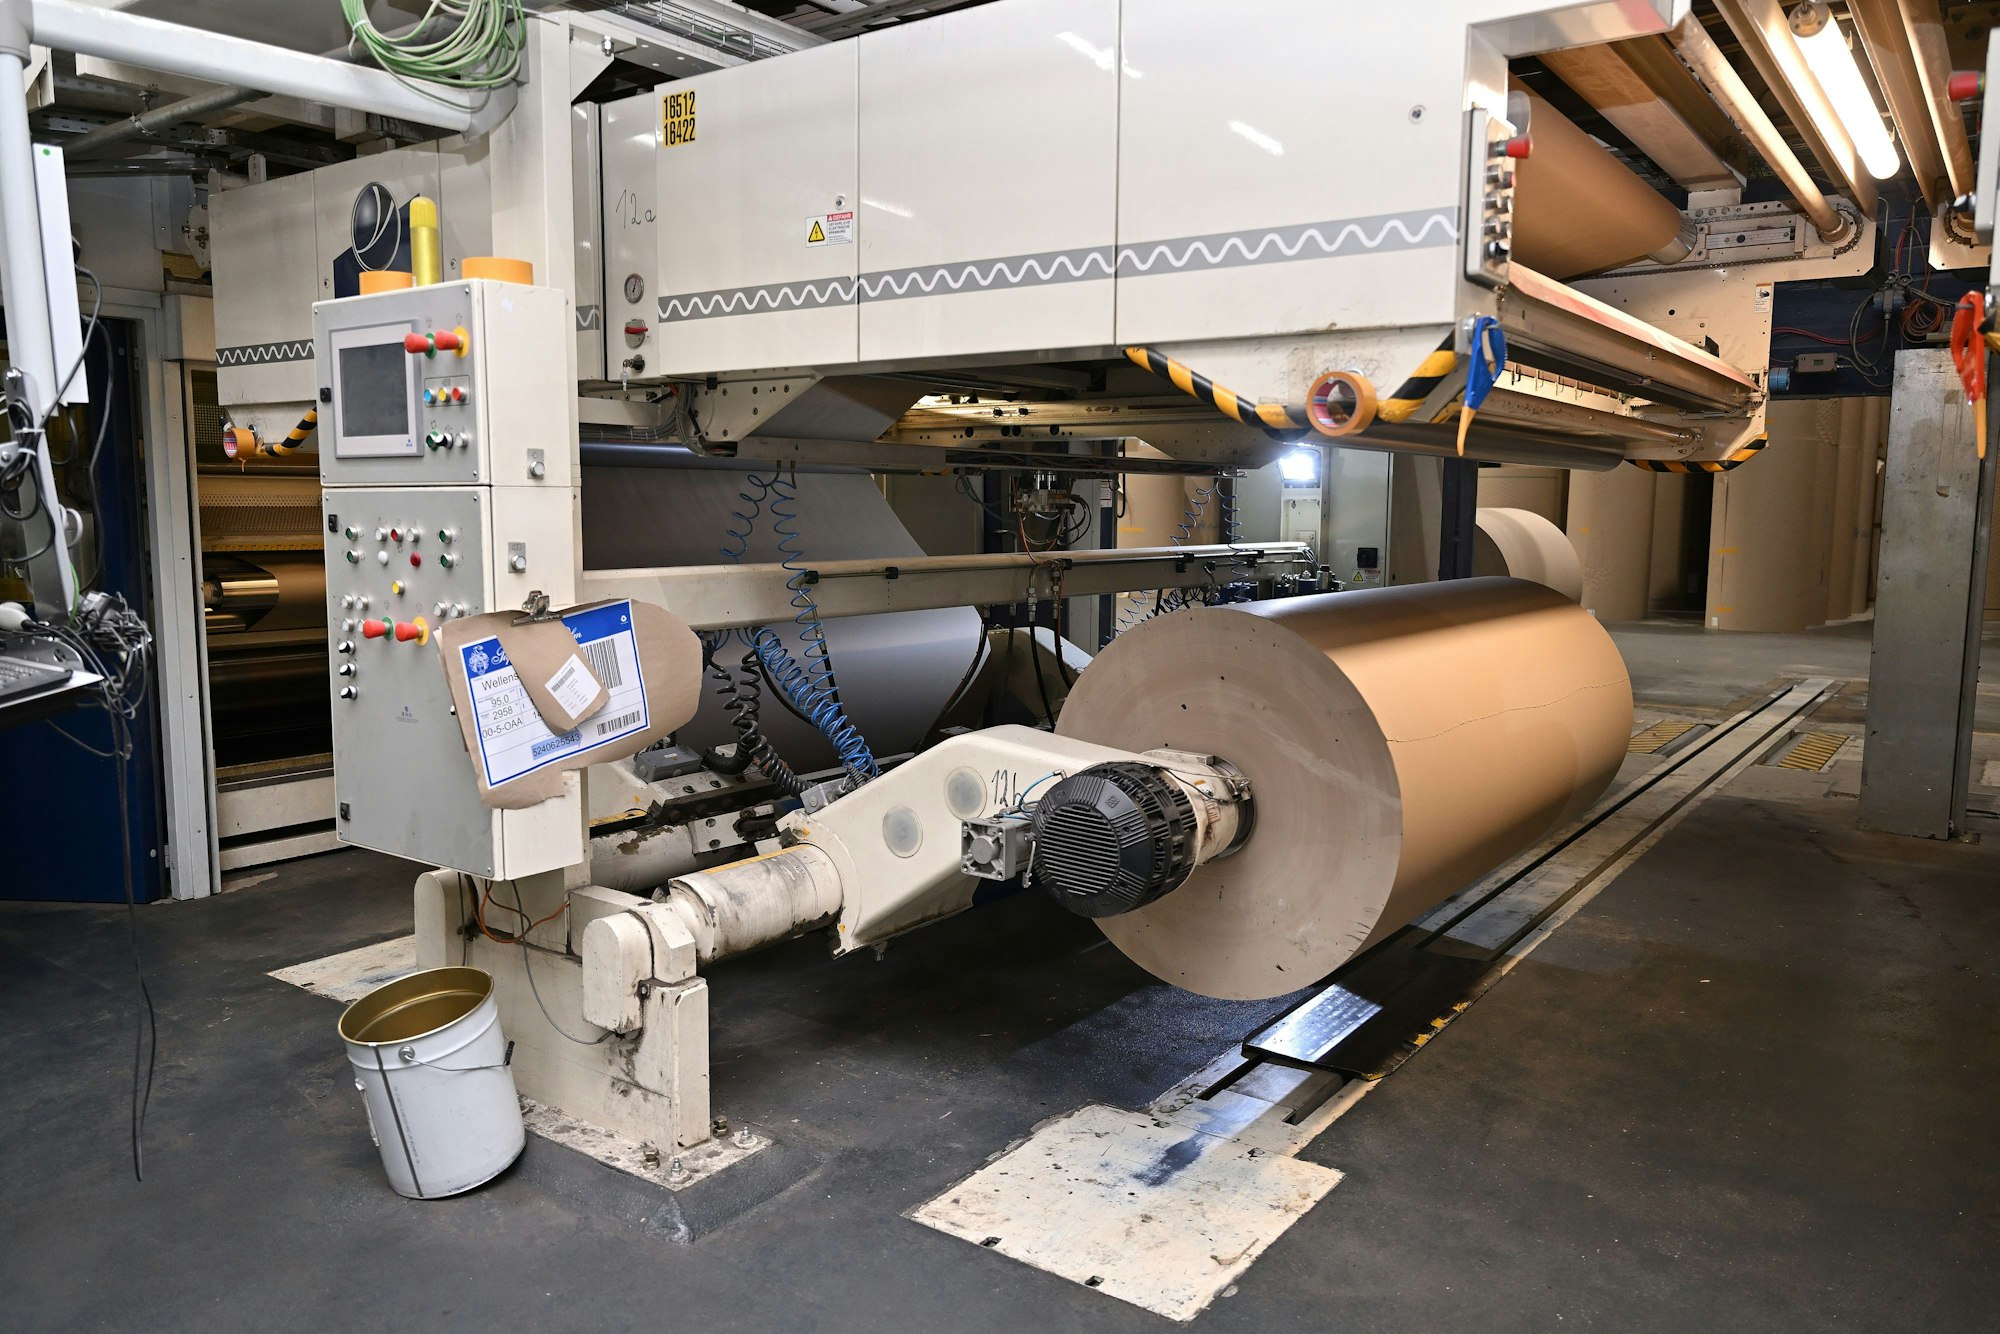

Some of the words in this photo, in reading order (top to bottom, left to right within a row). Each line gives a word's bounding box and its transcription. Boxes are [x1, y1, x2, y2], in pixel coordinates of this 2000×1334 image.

[663, 91, 696, 120] 16512
[663, 117, 696, 146] 16422
[615, 188, 657, 230] 12a
[492, 705, 514, 721] 2958
[532, 733, 582, 757] 5240625543
